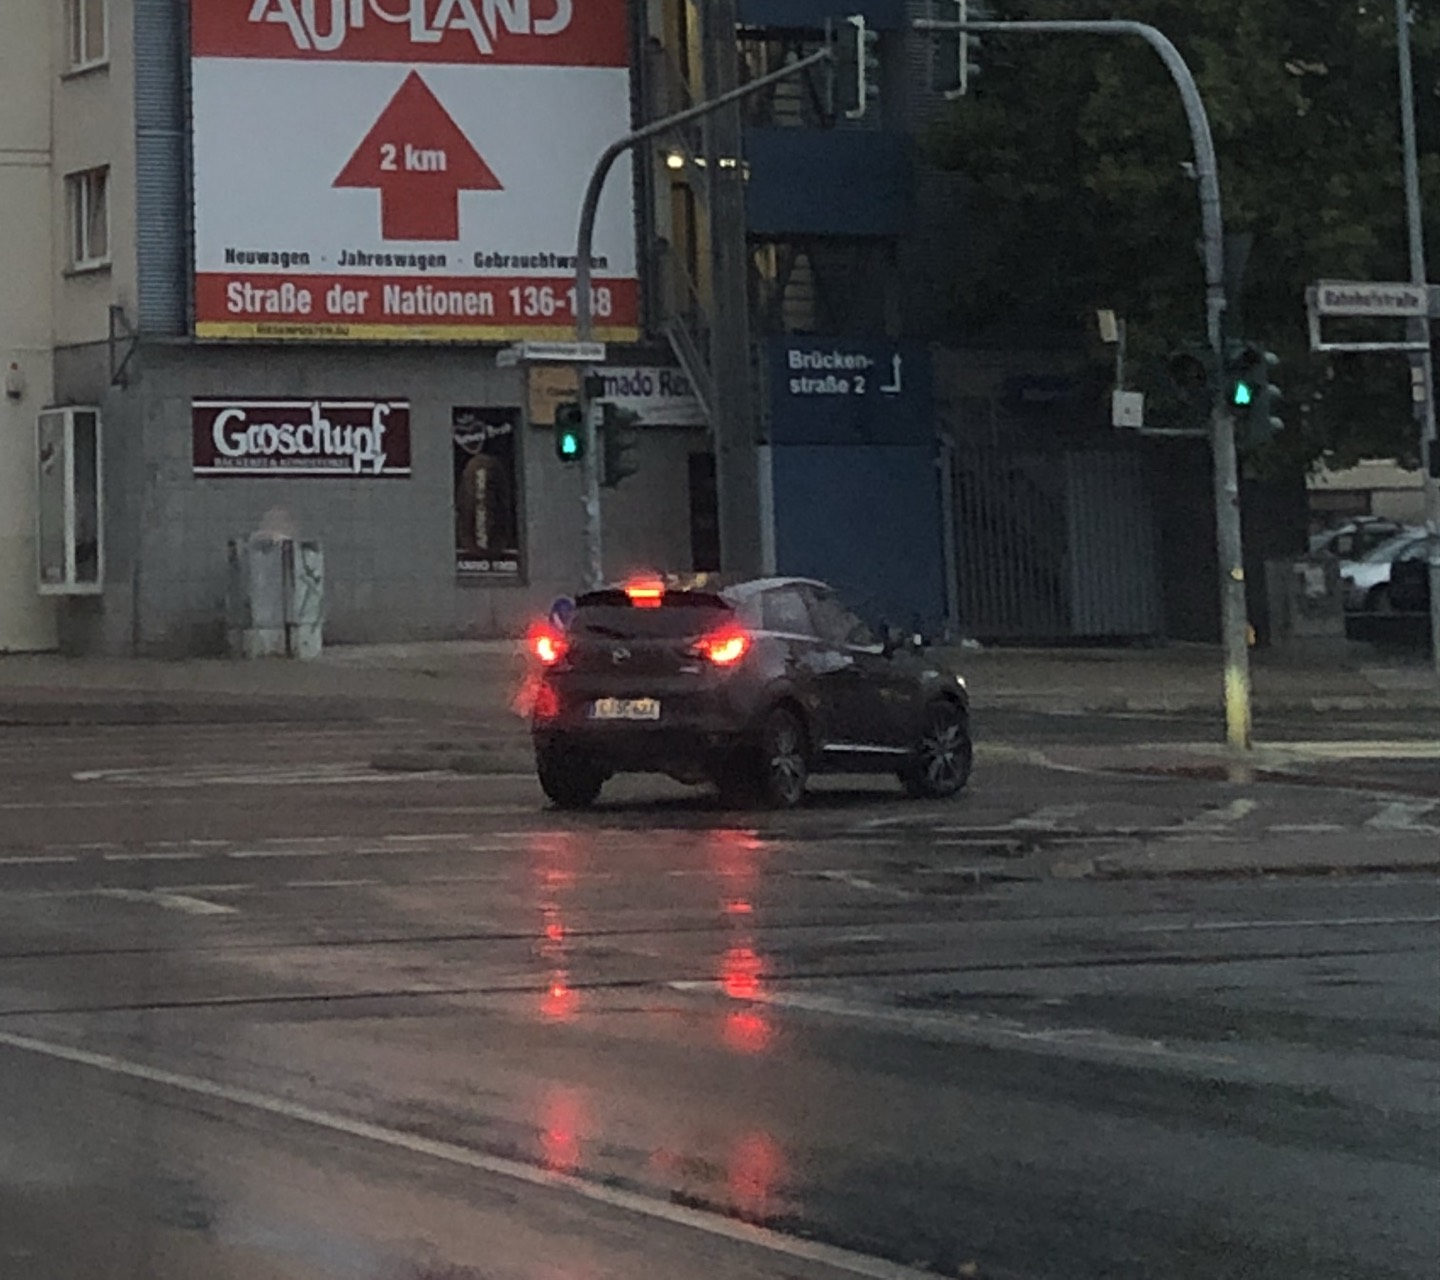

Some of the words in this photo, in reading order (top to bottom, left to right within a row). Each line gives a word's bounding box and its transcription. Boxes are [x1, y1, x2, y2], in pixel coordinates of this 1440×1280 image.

[379, 144, 397, 171] 2
[404, 143, 447, 171] km
[224, 247, 311, 267] Neuwagen
[337, 247, 447, 269] Jahreswagen
[473, 250, 608, 271] Gebrauchtwaen
[226, 281, 312, 315] Straße
[326, 282, 368, 315] der
[383, 284, 494, 317] Nationen
[789, 374, 850, 395] straße
[853, 376, 866, 395] 2
[213, 401, 391, 475] Groschupf
